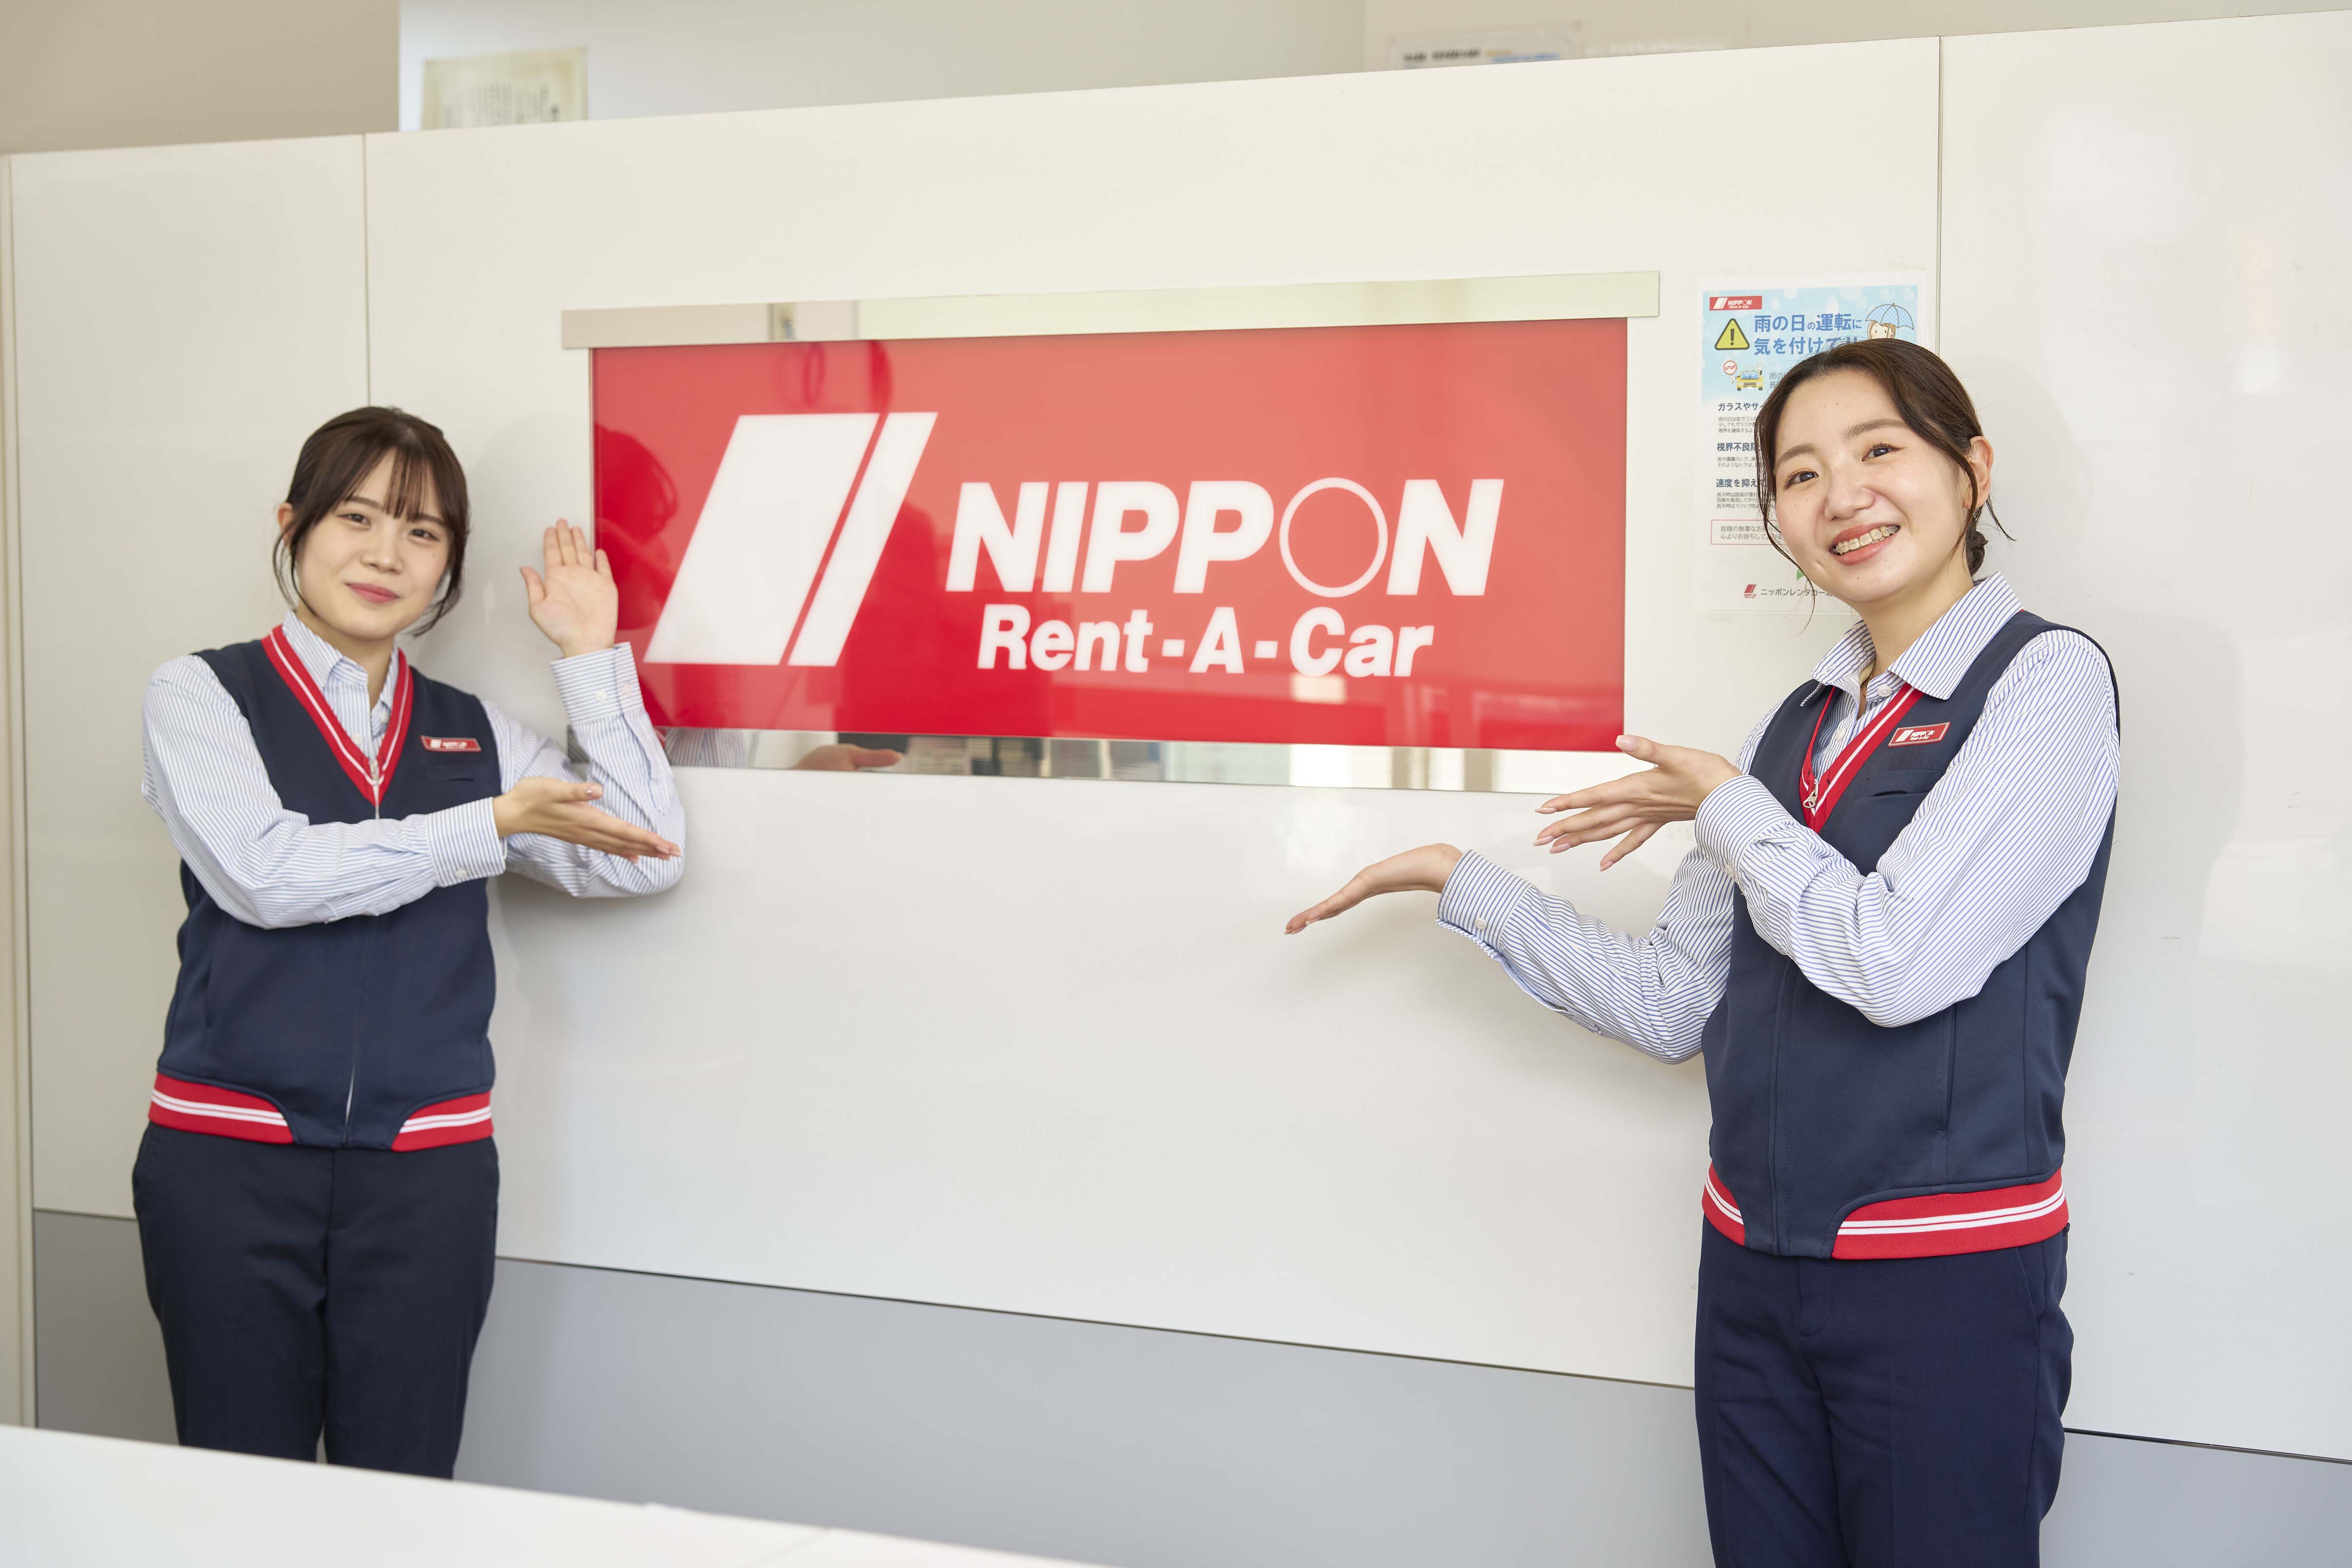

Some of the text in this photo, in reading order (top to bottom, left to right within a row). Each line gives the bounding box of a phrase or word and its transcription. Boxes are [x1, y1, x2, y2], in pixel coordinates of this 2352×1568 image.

[1754, 313, 1862, 332] 雨の日の運転に
[1718, 402, 1763, 411] ガラスやサ
[945, 476, 1504, 598] NIPPON
